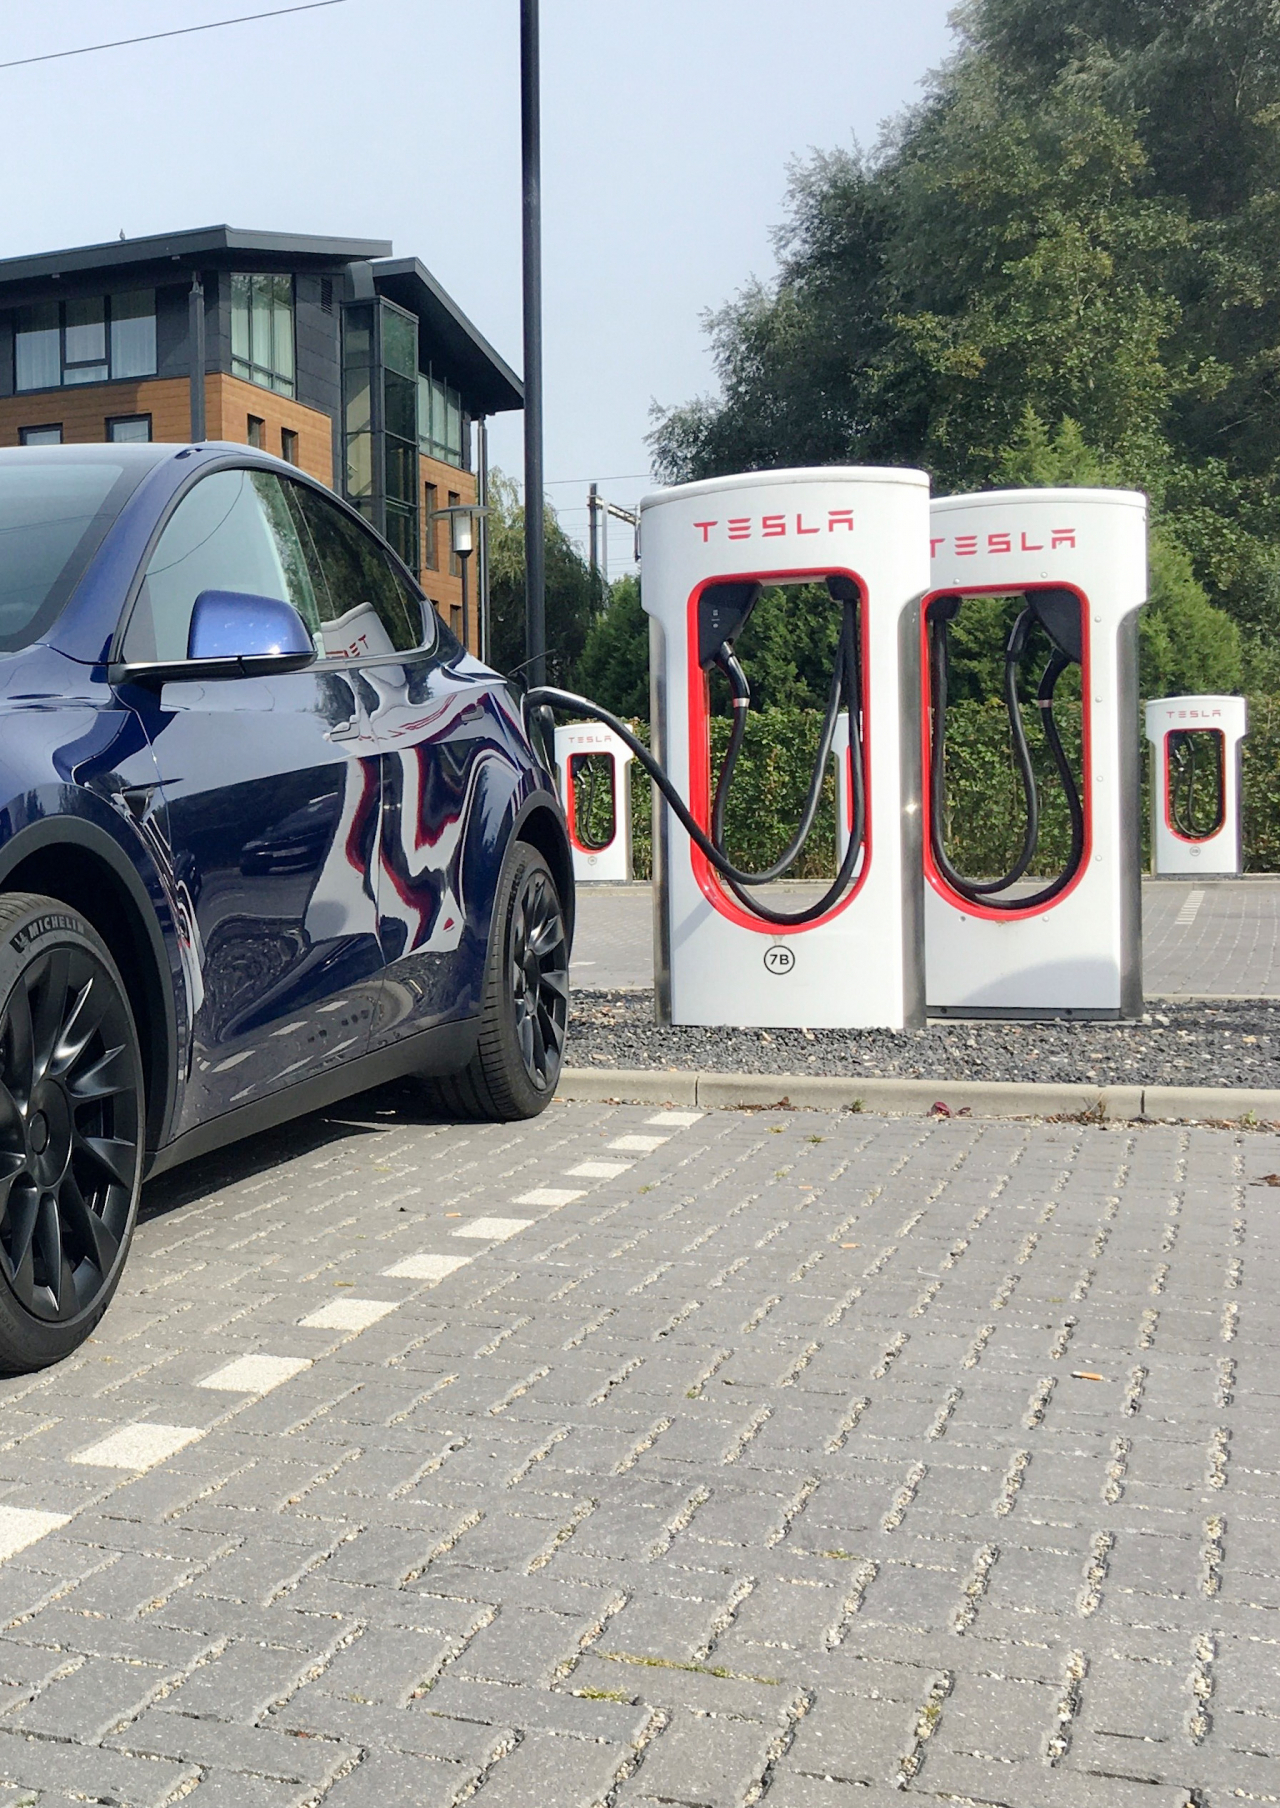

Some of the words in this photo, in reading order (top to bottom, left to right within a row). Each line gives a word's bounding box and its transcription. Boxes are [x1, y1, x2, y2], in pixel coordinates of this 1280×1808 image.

[692, 509, 855, 543] TESLA
[929, 528, 1077, 559] TESLA
[1165, 709, 1222, 719] TESLA
[568, 735, 612, 743] TESLA
[27, 915, 85, 939] MICHELIN
[769, 953, 790, 965] 7B
